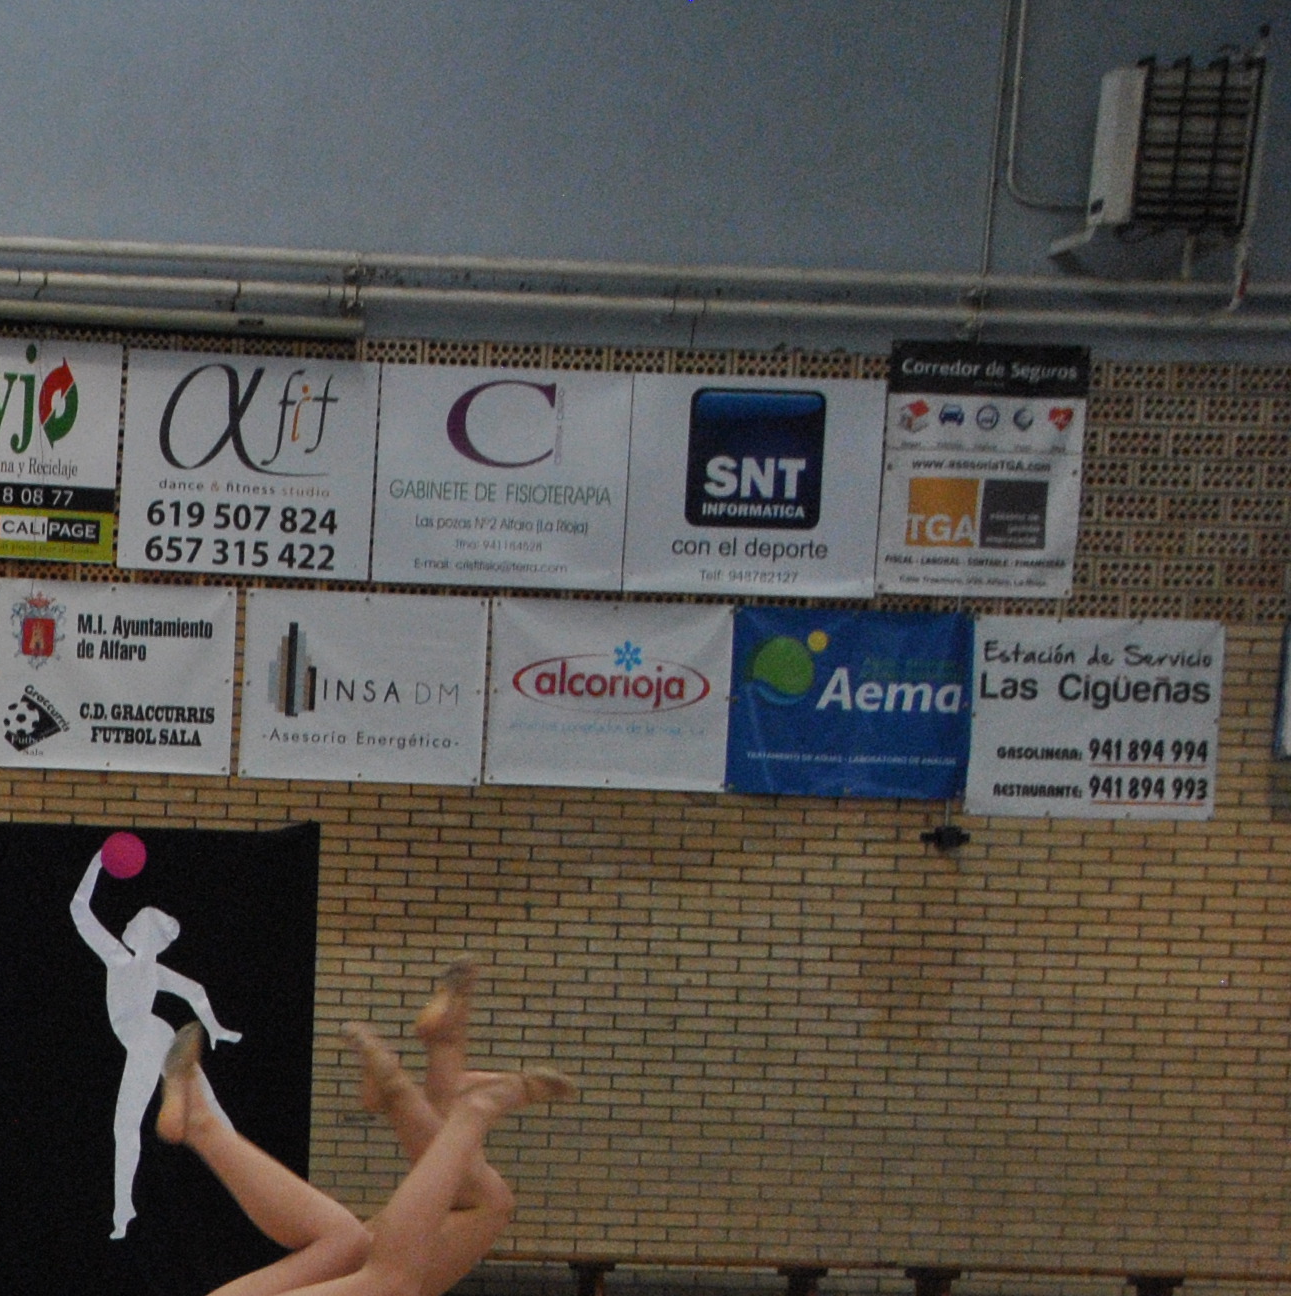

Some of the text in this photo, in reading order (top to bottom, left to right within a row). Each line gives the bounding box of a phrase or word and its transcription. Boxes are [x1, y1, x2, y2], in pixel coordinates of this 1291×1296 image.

[902, 358, 1078, 383] Corredor de Seguros
[17, 462, 26, 477] y
[28, 457, 78, 480] Reciclaje
[703, 455, 806, 499] SNT
[21, 487, 43, 505] 08
[51, 490, 74, 507] 77
[159, 479, 204, 491] dance
[226, 482, 275, 495] fitness
[281, 485, 330, 497] studio
[389, 479, 468, 501] GABINETE
[475, 482, 497, 502] DE
[147, 500, 338, 536] 619 507 824
[701, 502, 805, 518] INFORMATICA
[415, 515, 433, 528] Las
[499, 519, 534, 531] Alfaro
[907, 512, 975, 543] TGA
[144, 535, 335, 571] 657 315 422
[672, 537, 828, 562] con el deporte
[77, 613, 213, 639] M.I. Ayuntamiento
[77, 638, 147, 661] de Alfaro
[984, 640, 1212, 668] Estación de Servicio
[323, 678, 459, 705] INSA DM
[535, 659, 685, 709] alcorioja
[816, 666, 963, 714] Aema
[980, 671, 1211, 710] Las Cigüeñas
[24, 684, 70, 732] Graccurris
[79, 702, 215, 724] C.D. GRACCURRIS
[91, 726, 201, 747] FUTBOL SALA
[1089, 738, 1122, 761] 941
[1128, 739, 1164, 762] 894
[1172, 740, 1208, 763] 994
[1089, 775, 1122, 799] 941
[1128, 776, 1164, 800] 894
[1172, 776, 1208, 800] 993
